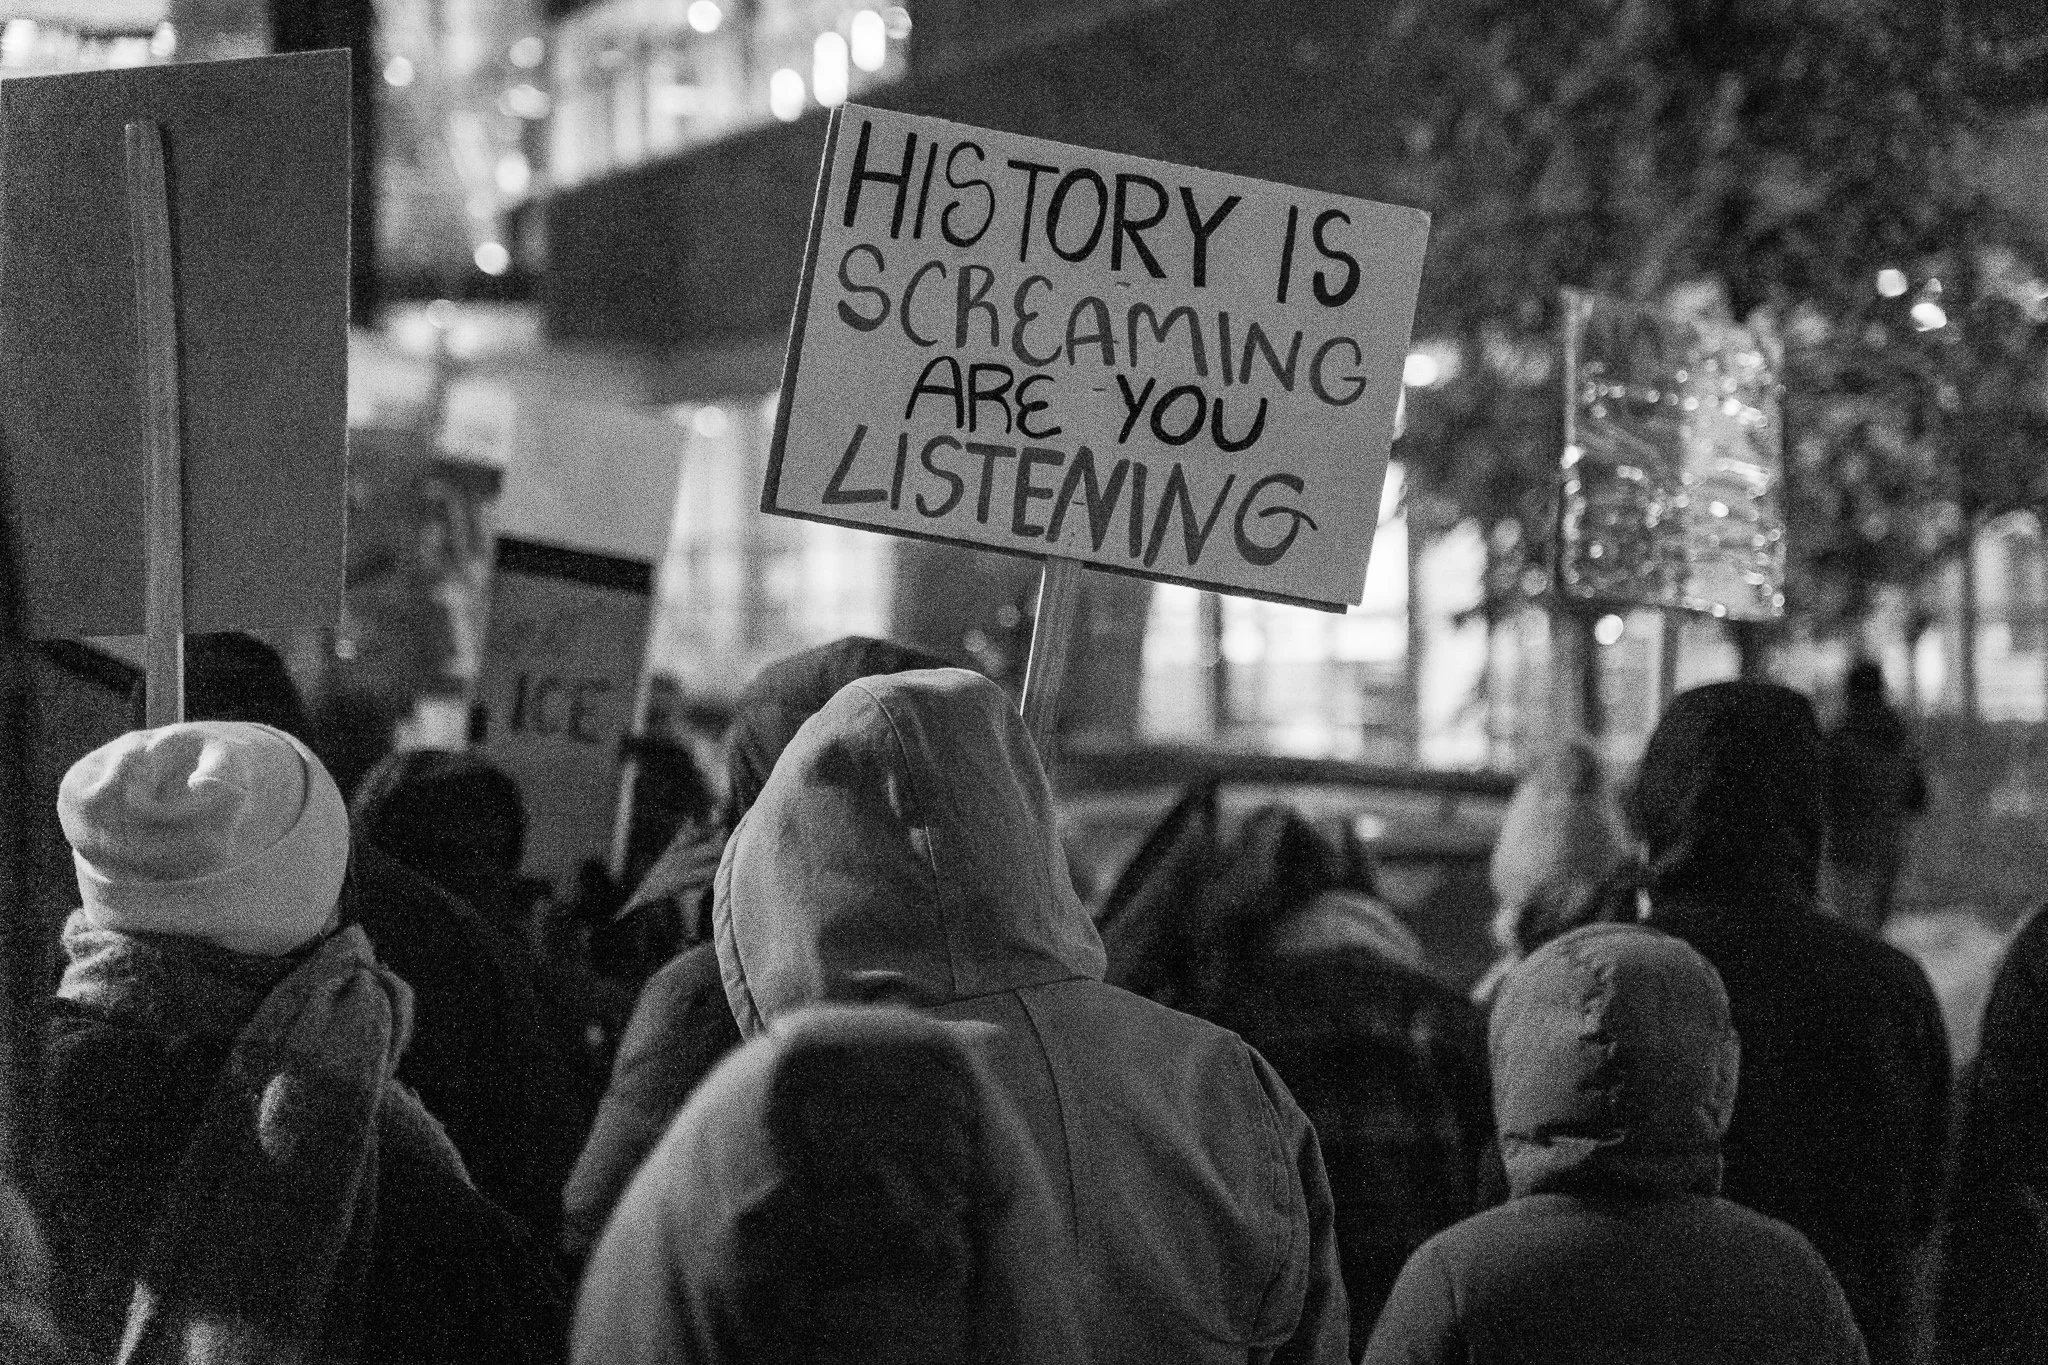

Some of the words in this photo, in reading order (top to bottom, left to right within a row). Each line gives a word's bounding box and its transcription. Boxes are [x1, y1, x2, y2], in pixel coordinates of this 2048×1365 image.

[844, 120, 1241, 287] HISTORY
[1277, 205, 1361, 307] IS
[837, 244, 1366, 406] SCREAMING
[905, 356, 1062, 438] ARE
[1117, 373, 1268, 452] YOU
[822, 425, 1318, 566] LISTENING
